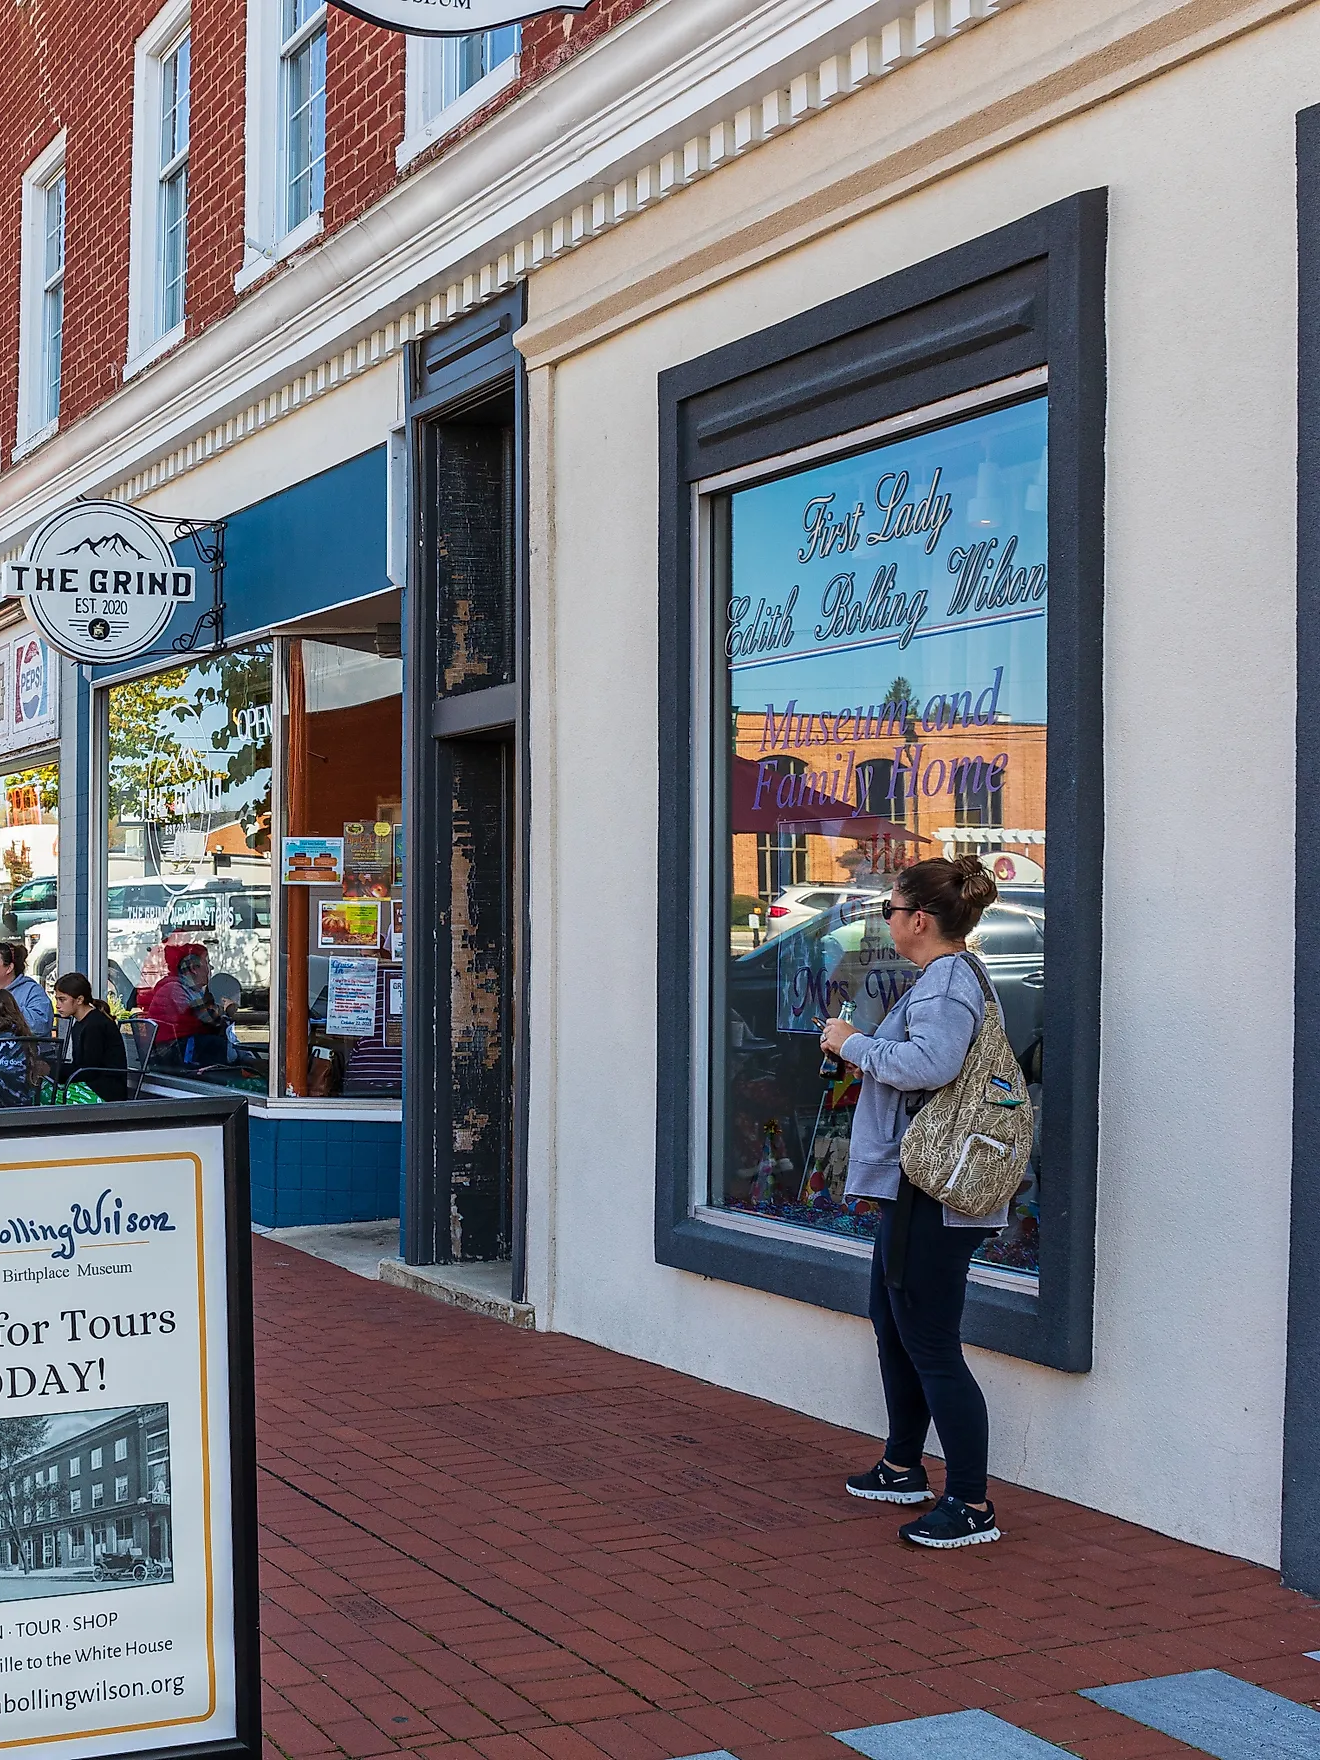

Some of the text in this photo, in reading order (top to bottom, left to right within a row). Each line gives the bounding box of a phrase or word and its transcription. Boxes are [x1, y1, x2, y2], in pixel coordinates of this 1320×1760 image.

[797, 467, 954, 564] First Lady
[11, 566, 194, 597] THE GRIND
[724, 534, 1048, 659] Edith Bolling Wilson
[75, 598, 129, 616] EST. 2020
[20, 664, 44, 695] PEPSI
[236, 704, 274, 742] OPEN
[758, 666, 1005, 752] Museum and
[751, 742, 1010, 818] Family Home
[204, 906, 235, 928] STOPS
[70, 1188, 177, 1237] Wilson
[2, 1266, 70, 1286] Birthplace
[76, 1261, 133, 1279] Museum
[59, 1308, 178, 1342] Tours
[15, 1619, 62, 1639] TOUR
[73, 1611, 119, 1633] SHOP
[26, 1654, 43, 1671] to
[46, 1650, 72, 1669] the
[74, 1643, 122, 1664] White
[126, 1638, 173, 1657] House
